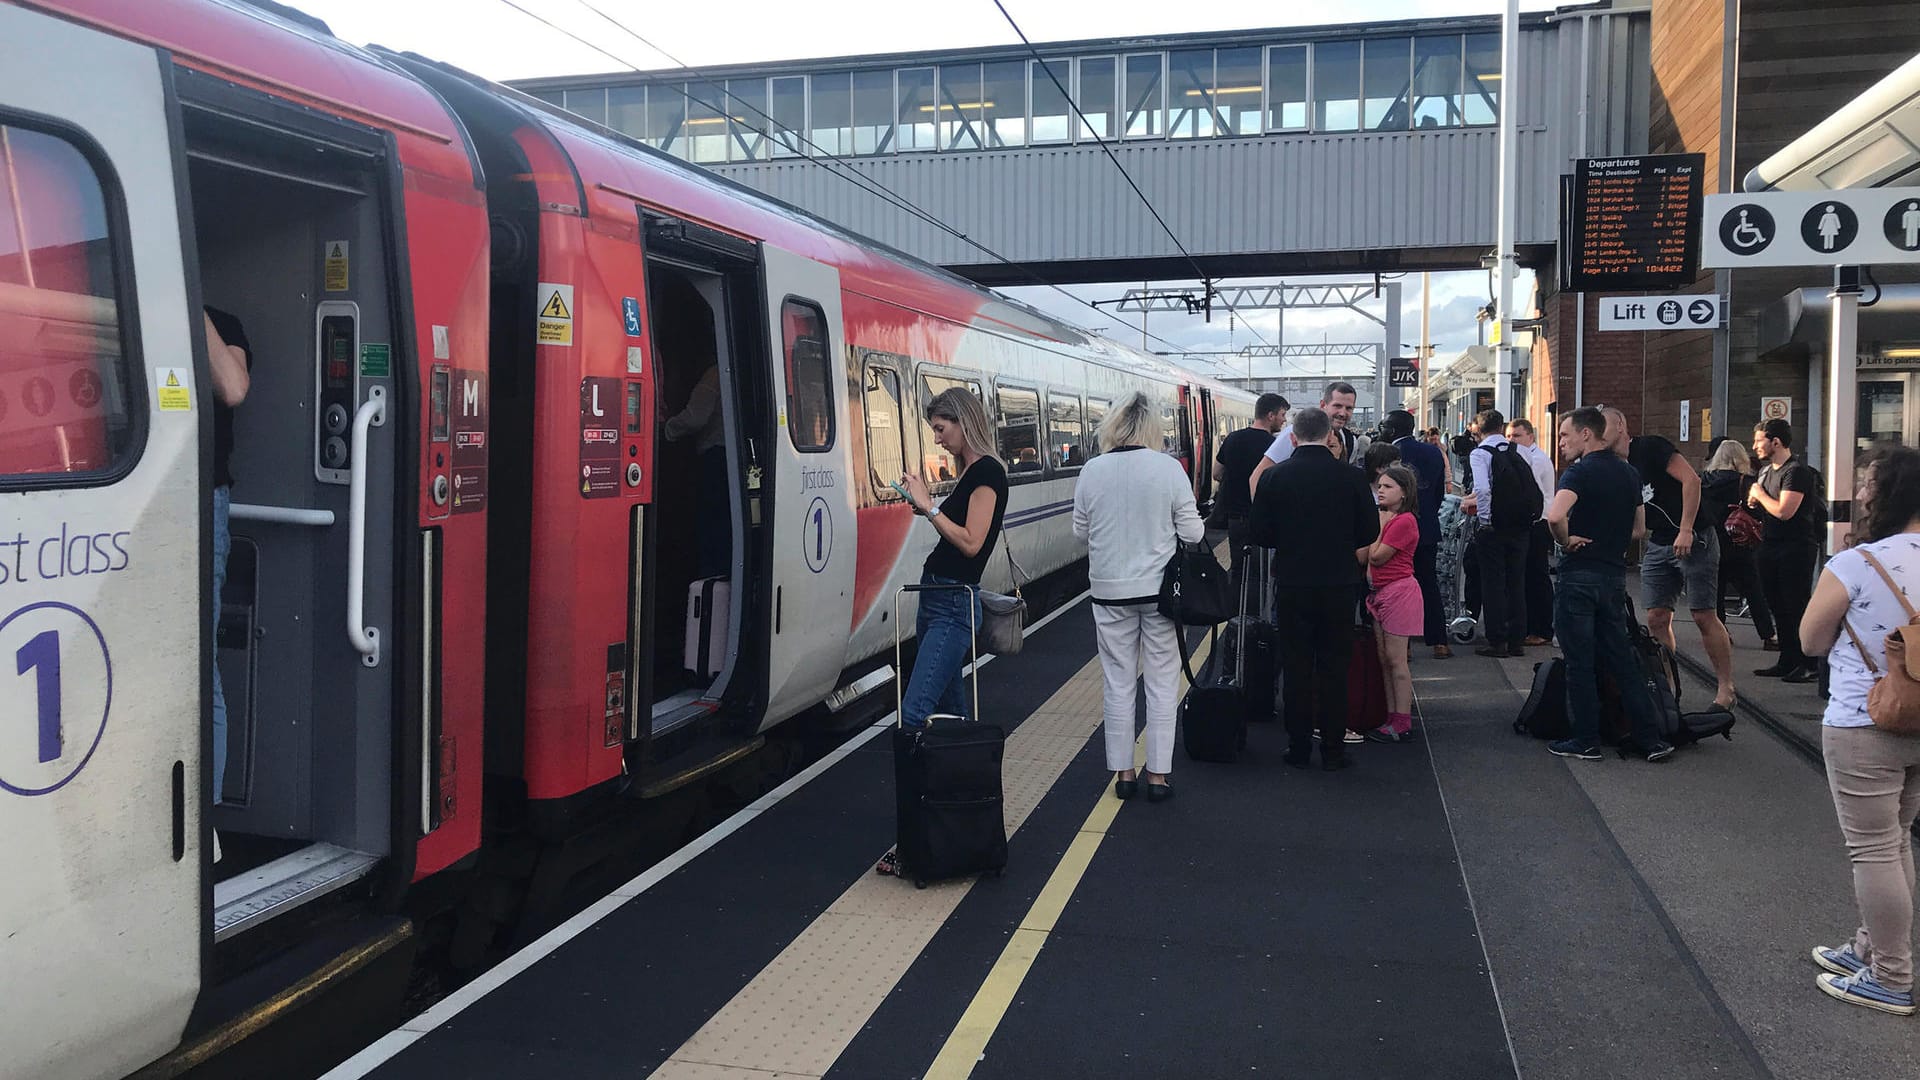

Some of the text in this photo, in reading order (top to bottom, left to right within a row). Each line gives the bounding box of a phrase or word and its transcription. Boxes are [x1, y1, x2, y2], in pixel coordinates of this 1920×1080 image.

[1588, 159, 1640, 170] Departures
[1614, 304, 1646, 320] Lift
[1392, 370, 1416, 382] J/K
[463, 378, 479, 417] M
[592, 384, 604, 416] L
[38, 521, 131, 580] class
[814, 508, 822, 561] 1
[16, 629, 62, 764] 1
